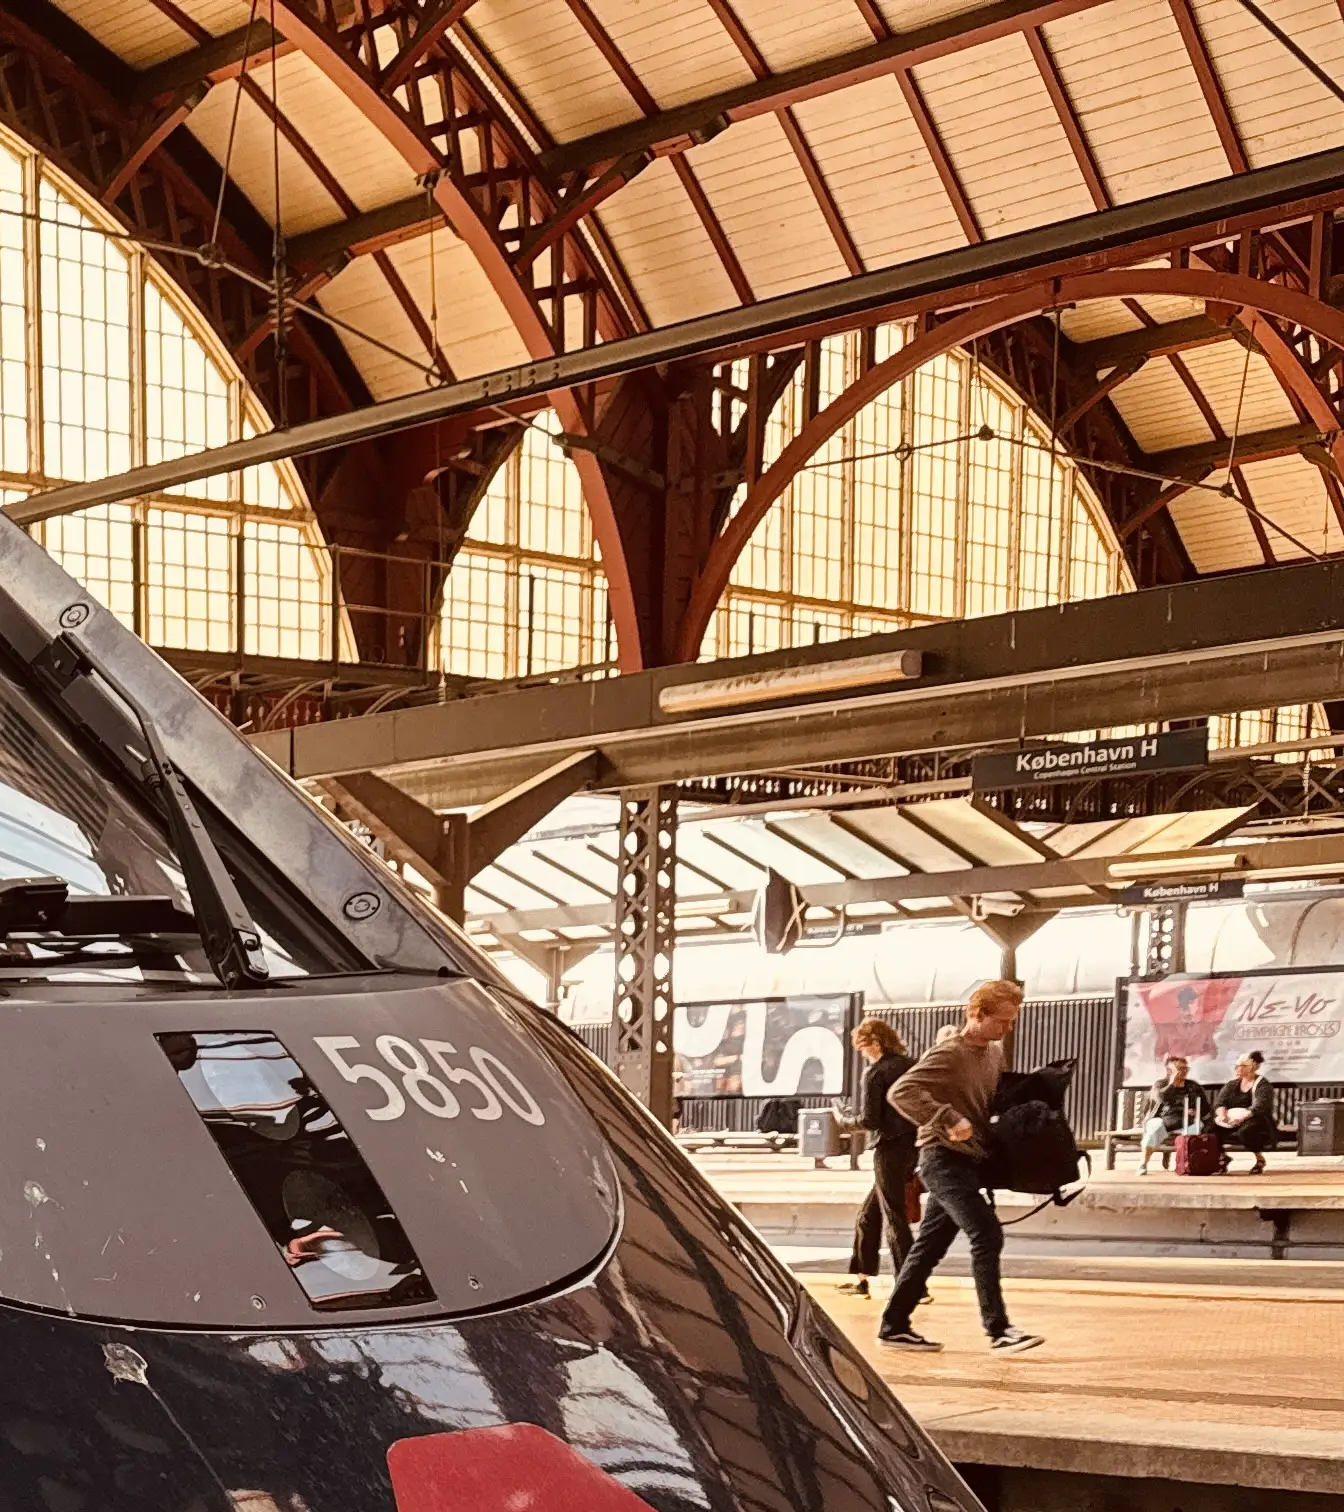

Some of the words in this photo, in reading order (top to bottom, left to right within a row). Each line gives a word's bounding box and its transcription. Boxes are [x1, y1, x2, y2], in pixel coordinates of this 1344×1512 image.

[1016, 746, 1134, 772] København
[1140, 738, 1158, 757] H
[1143, 884, 1207, 898] København
[1208, 882, 1219, 892] H
[313, 1034, 545, 1126] 5850
